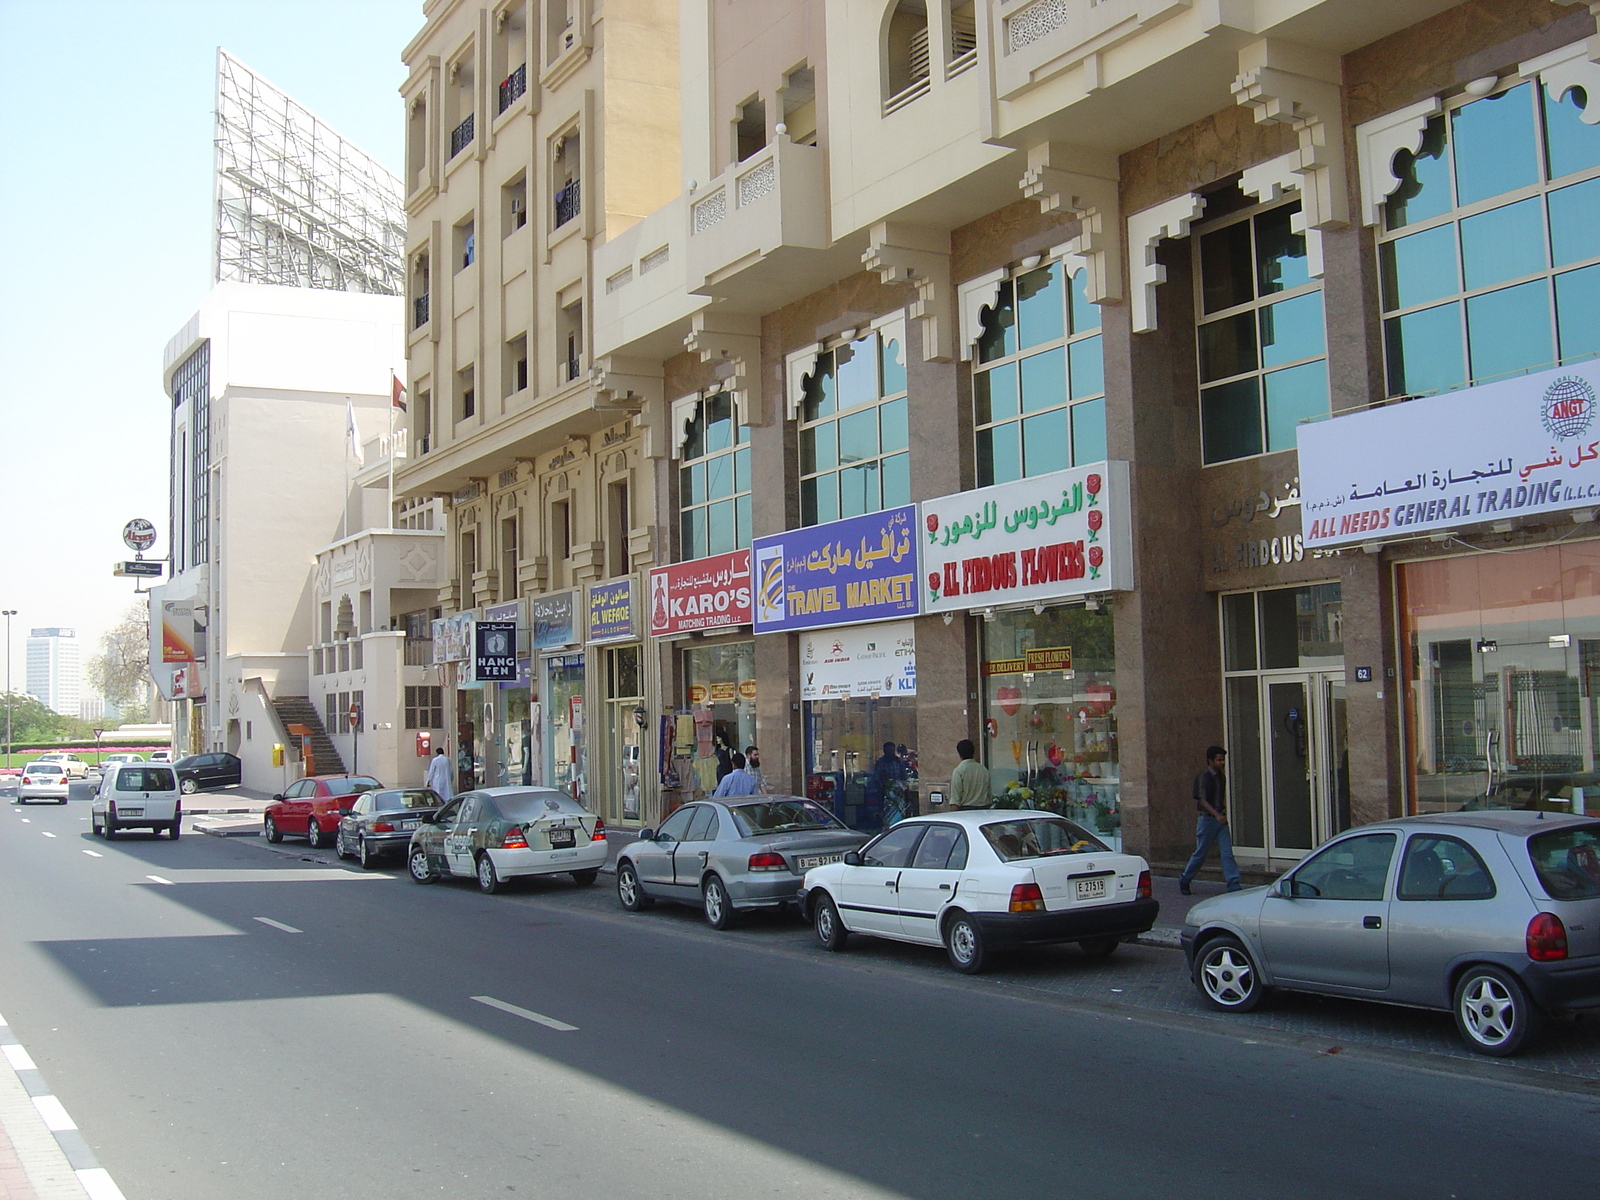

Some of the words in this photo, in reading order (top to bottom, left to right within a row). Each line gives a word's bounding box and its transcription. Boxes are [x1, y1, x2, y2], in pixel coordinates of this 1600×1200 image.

[1552, 399, 1584, 418] ANGT
[1518, 445, 1563, 483] شي
[1568, 441, 1600, 469] كل
[1349, 473, 1427, 501] العامة
[1432, 458, 1513, 492] للتجارة
[1004, 481, 1083, 534] الفردوس
[1308, 517, 1336, 540] ALL
[1339, 507, 1391, 536] NEEDS
[1394, 496, 1471, 527] GENERAL
[1476, 479, 1563, 514] TRADING
[940, 500, 997, 546] للزهور
[807, 541, 852, 574] ماركت
[855, 527, 910, 570] ترافيل
[1235, 534, 1304, 569] FIRDOUS
[712, 555, 750, 588] كاروس
[943, 561, 960, 597] AL
[962, 551, 1017, 595] FIRDOUS
[1021, 540, 1086, 586] FLOWERS
[609, 588, 629, 606] صالون
[670, 587, 751, 618] KARO'S
[787, 586, 841, 616] TRAVEL
[846, 573, 914, 608] MARKET
[591, 611, 600, 627] AL
[678, 618, 705, 630] MATCHING
[705, 614, 731, 627] TRADING
[478, 657, 515, 667] HANG
[484, 666, 509, 676] TEN
[996, 661, 1024, 672] DELIVERY
[1028, 651, 1044, 664] FRESH
[1045, 650, 1070, 663] FLOWERS
[1357, 669, 1368, 679] 62
[1078, 883, 1083, 892] E
[1085, 881, 1104, 892] 27519
